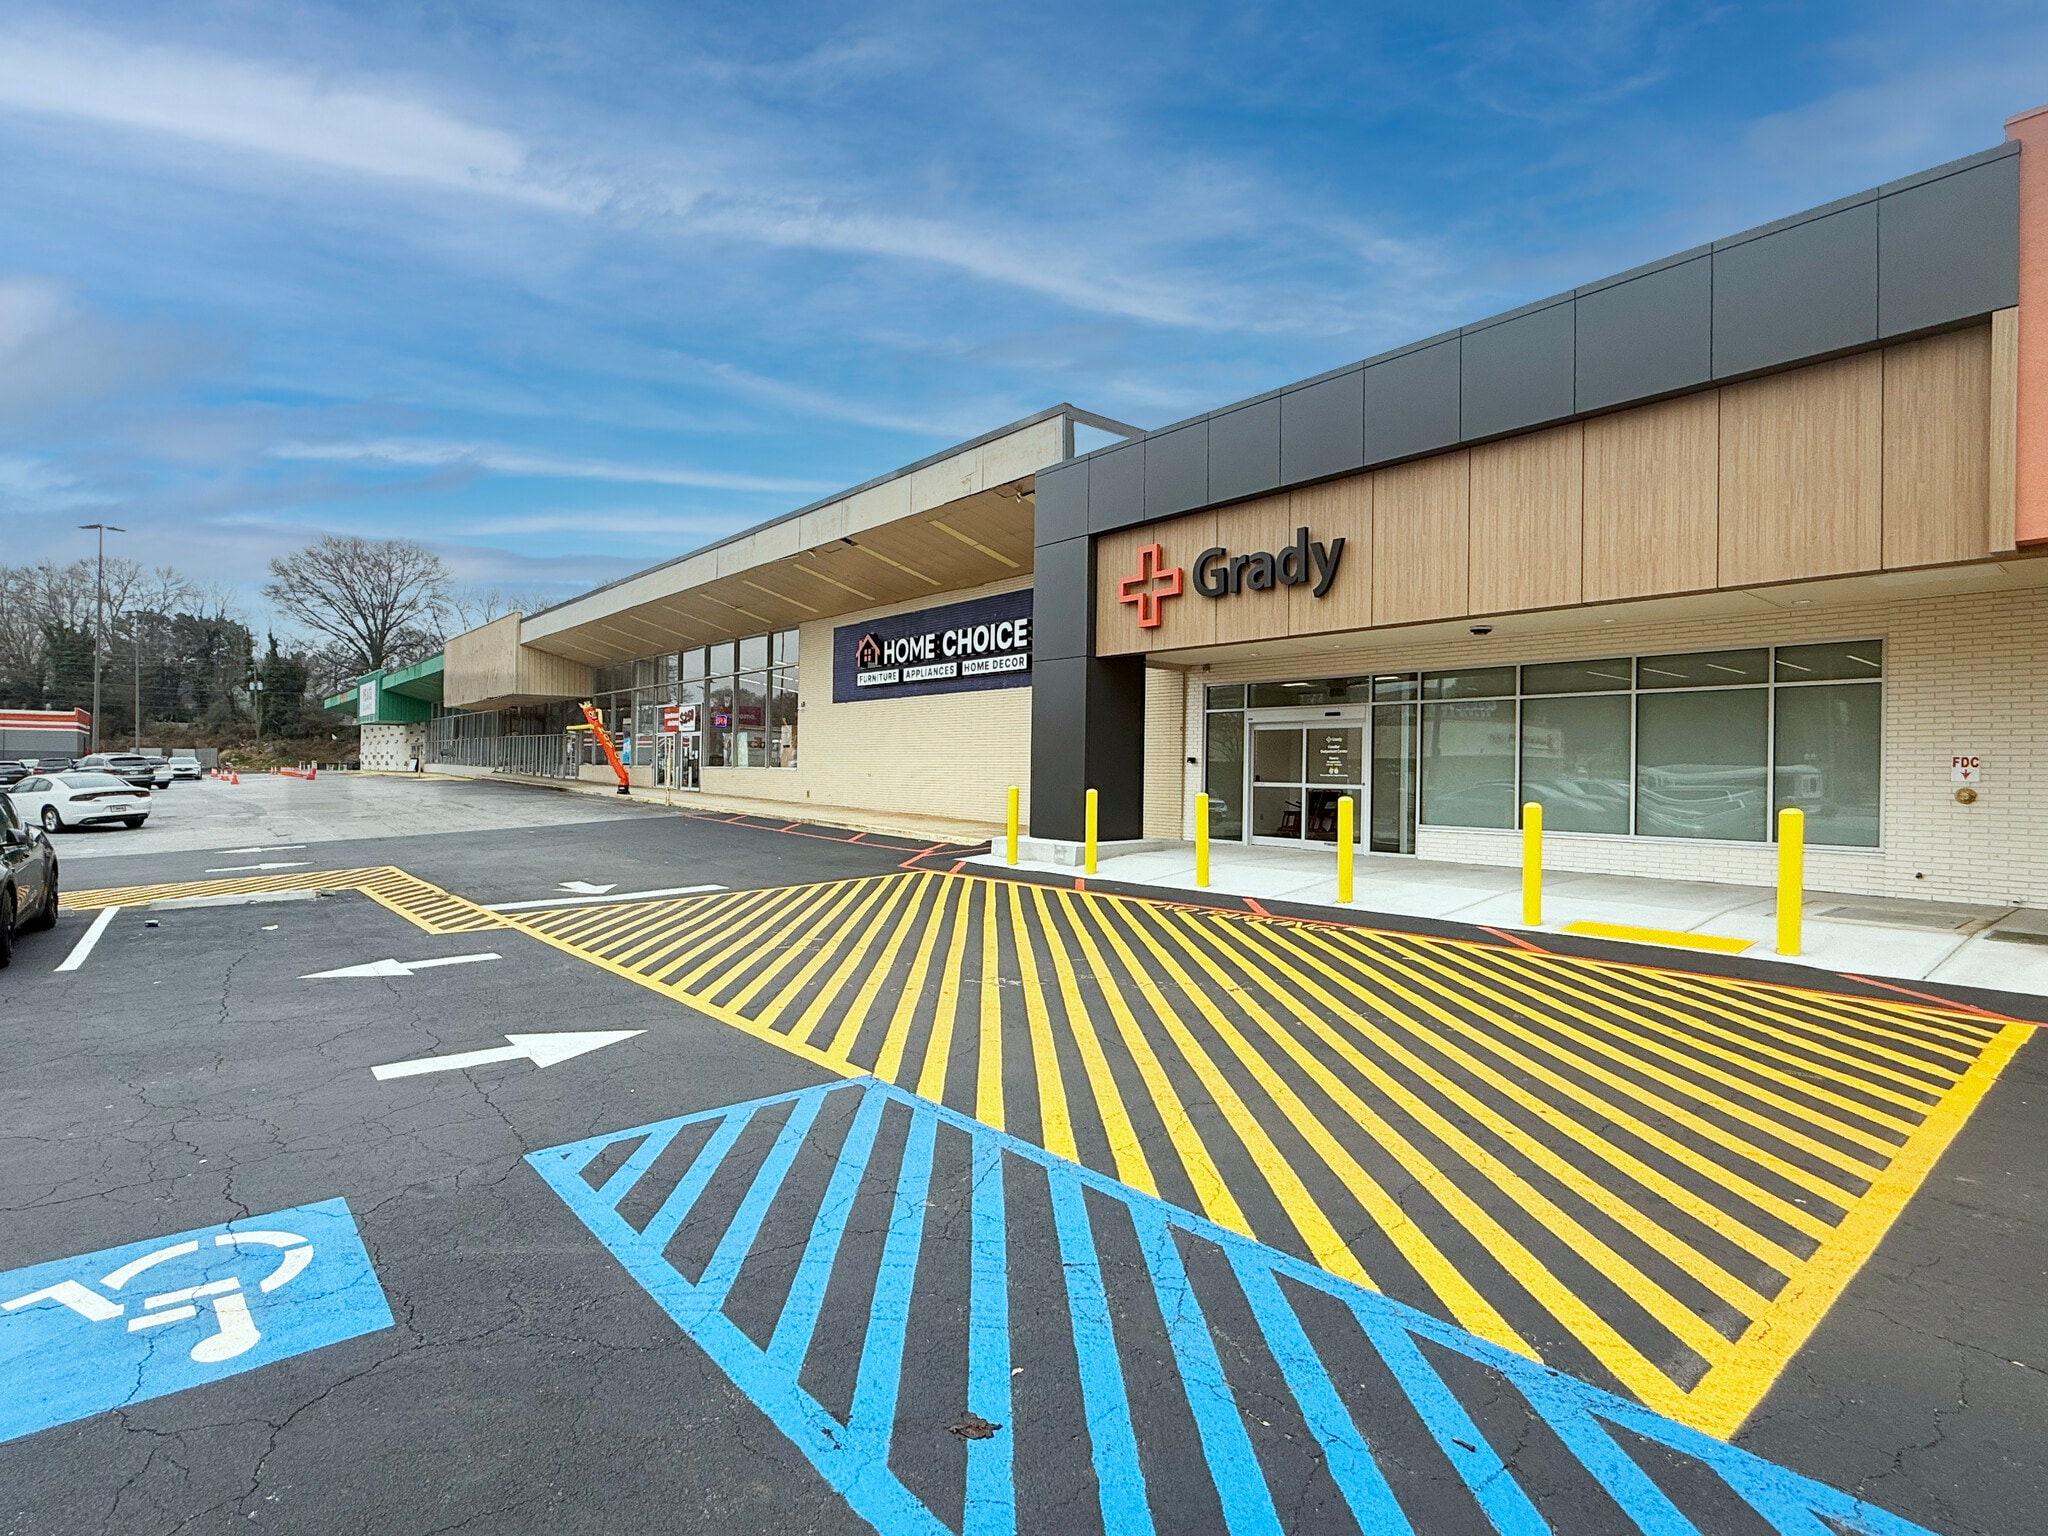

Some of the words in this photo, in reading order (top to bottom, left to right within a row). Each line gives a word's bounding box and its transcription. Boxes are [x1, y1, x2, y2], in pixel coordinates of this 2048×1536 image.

[1193, 527, 1346, 597] Grady
[884, 633, 935, 665] HOME
[943, 618, 1027, 657] CHOICE
[859, 672, 897, 683] FURNITURE
[905, 664, 954, 679] APPLIANCES
[964, 660, 990, 673] HOME
[993, 656, 1025, 670] DECOR
[1952, 756, 1980, 768] FDC
